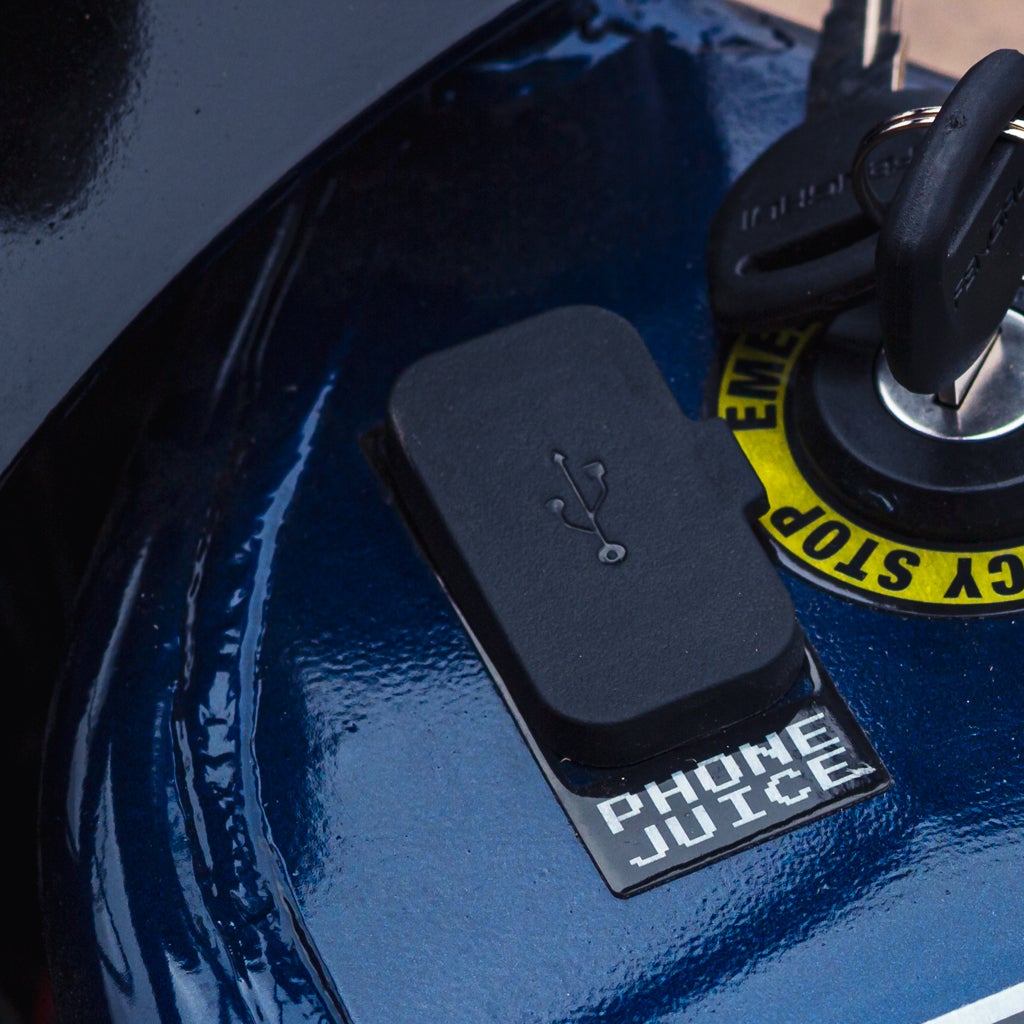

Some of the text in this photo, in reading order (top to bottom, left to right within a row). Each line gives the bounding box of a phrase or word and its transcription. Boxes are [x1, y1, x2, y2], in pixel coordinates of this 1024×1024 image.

[769, 505, 921, 592] STOP
[597, 712, 841, 835] PHONE
[629, 746, 864, 868] JUICE
